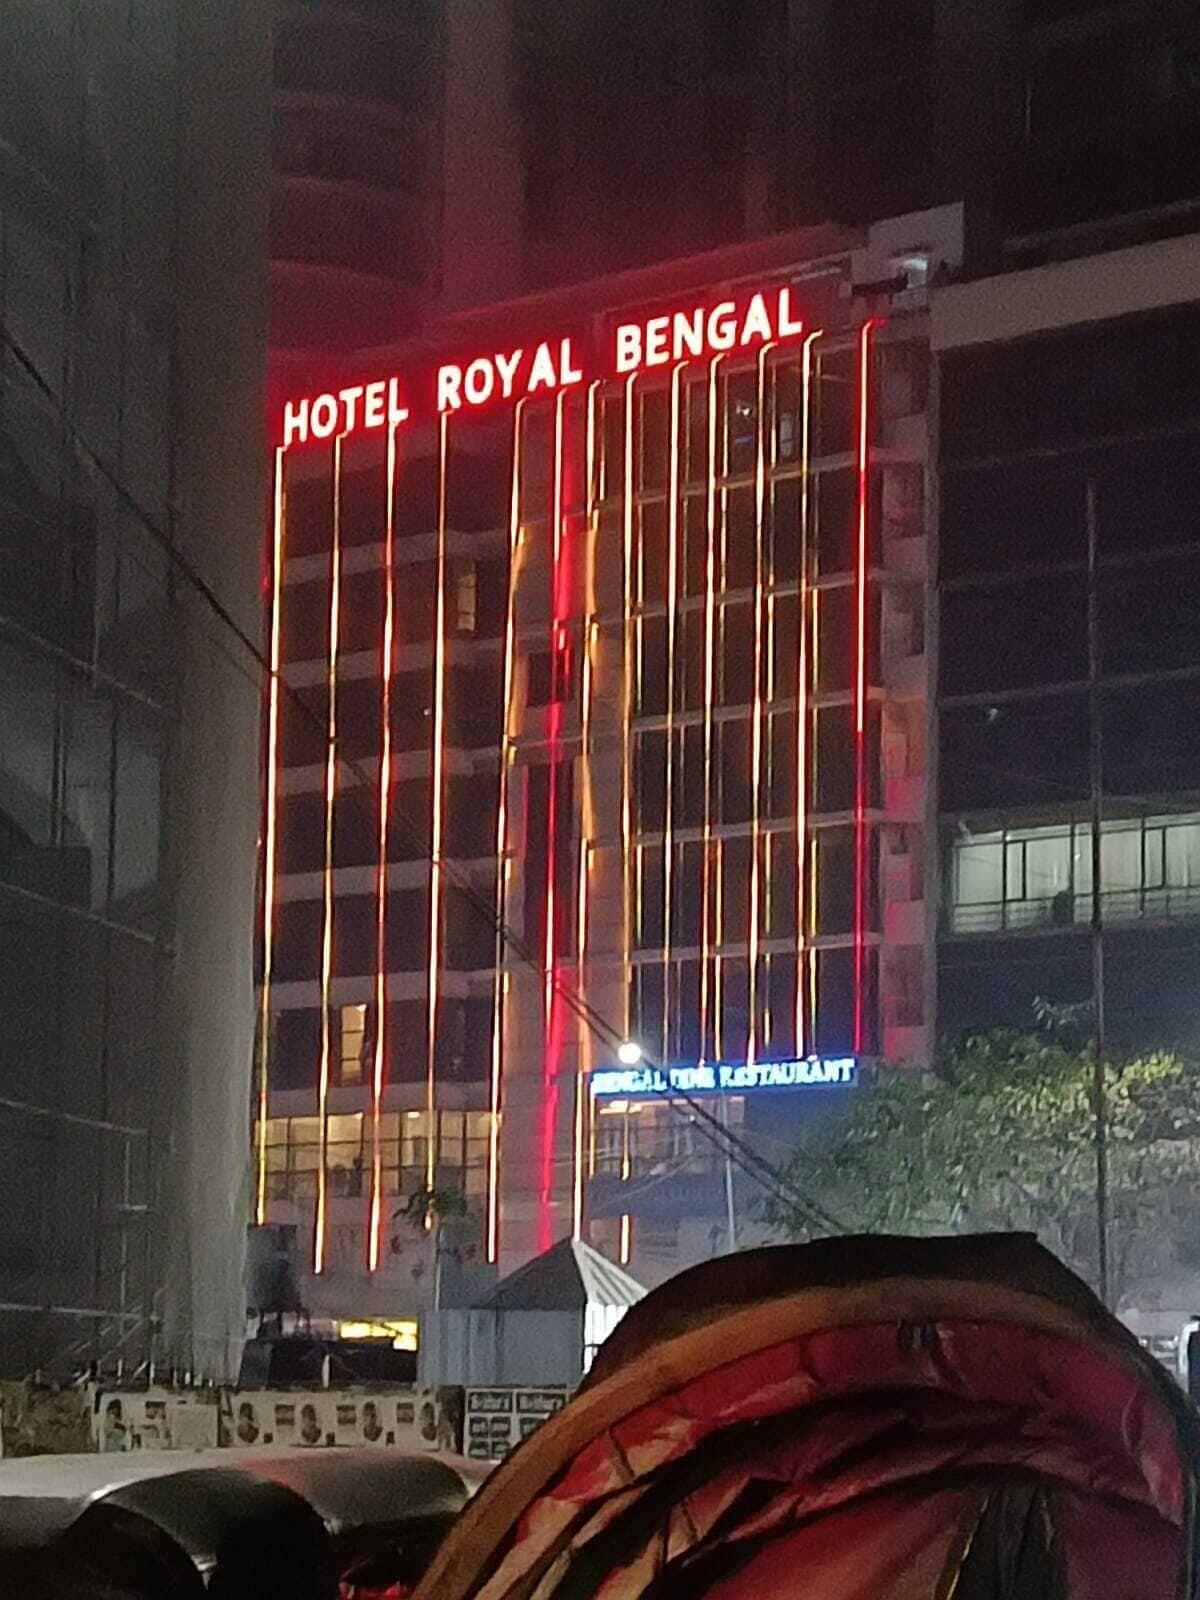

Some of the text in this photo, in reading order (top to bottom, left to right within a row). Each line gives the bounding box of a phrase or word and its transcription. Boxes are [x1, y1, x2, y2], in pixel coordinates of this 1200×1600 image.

[282, 287, 803, 446] HOTEL ROYAL BENGAL
[719, 1057, 856, 1088] RESTAURANT
